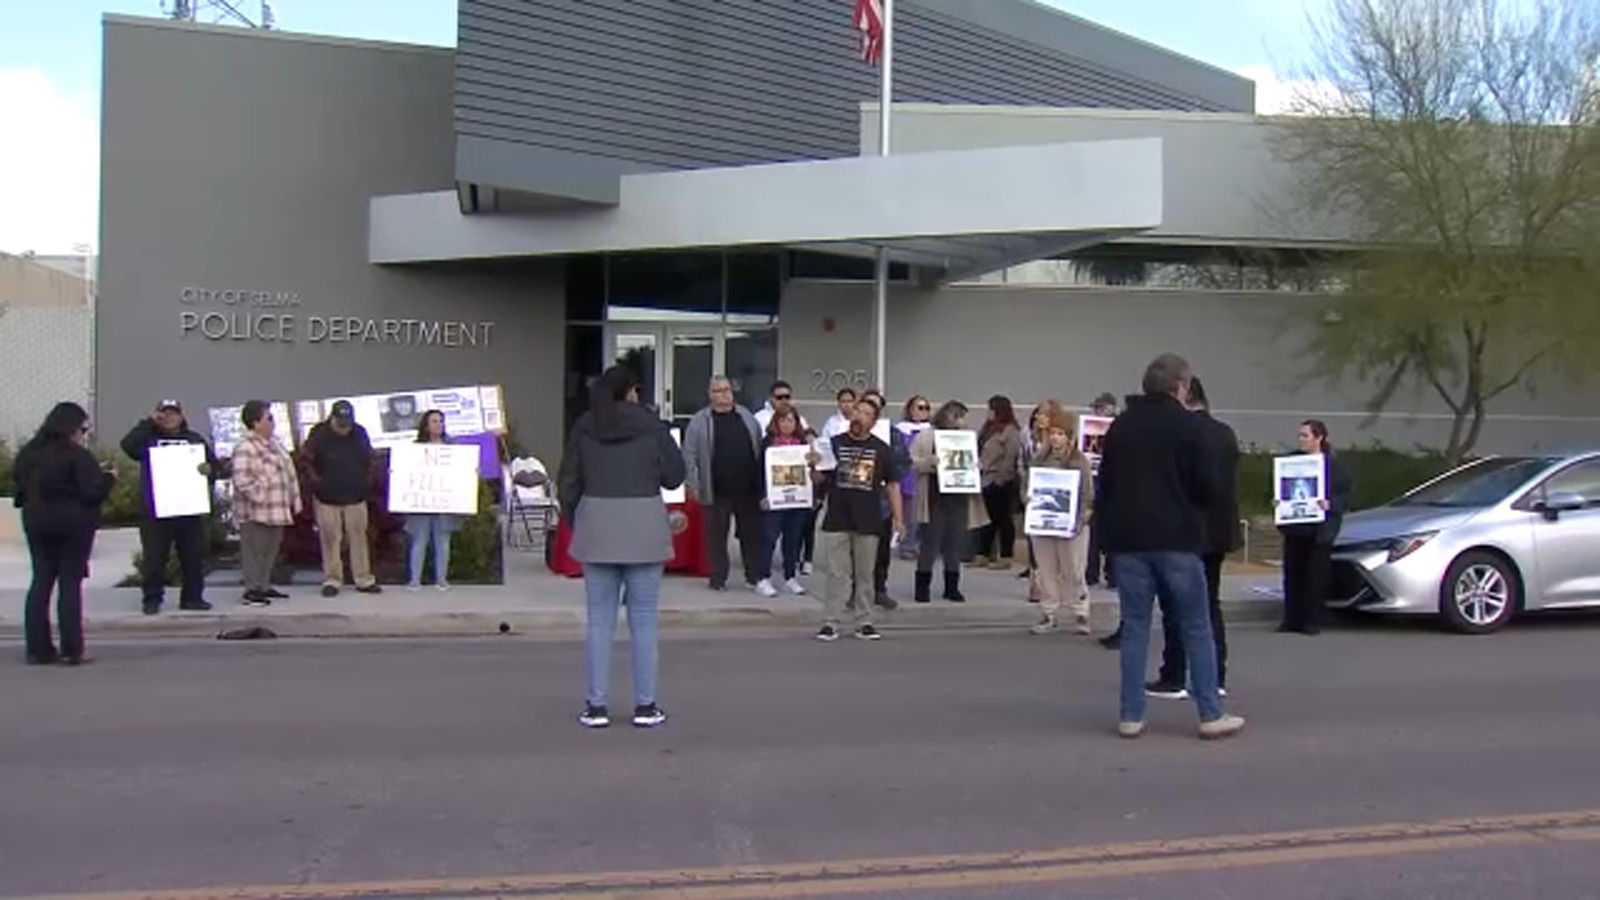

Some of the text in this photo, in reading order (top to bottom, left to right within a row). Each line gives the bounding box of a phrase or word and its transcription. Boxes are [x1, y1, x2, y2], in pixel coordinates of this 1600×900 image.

[180, 286, 301, 308] CITY OF SELMA
[180, 311, 495, 347] POLICE DEPARTMENT
[410, 447, 453, 466] NE
